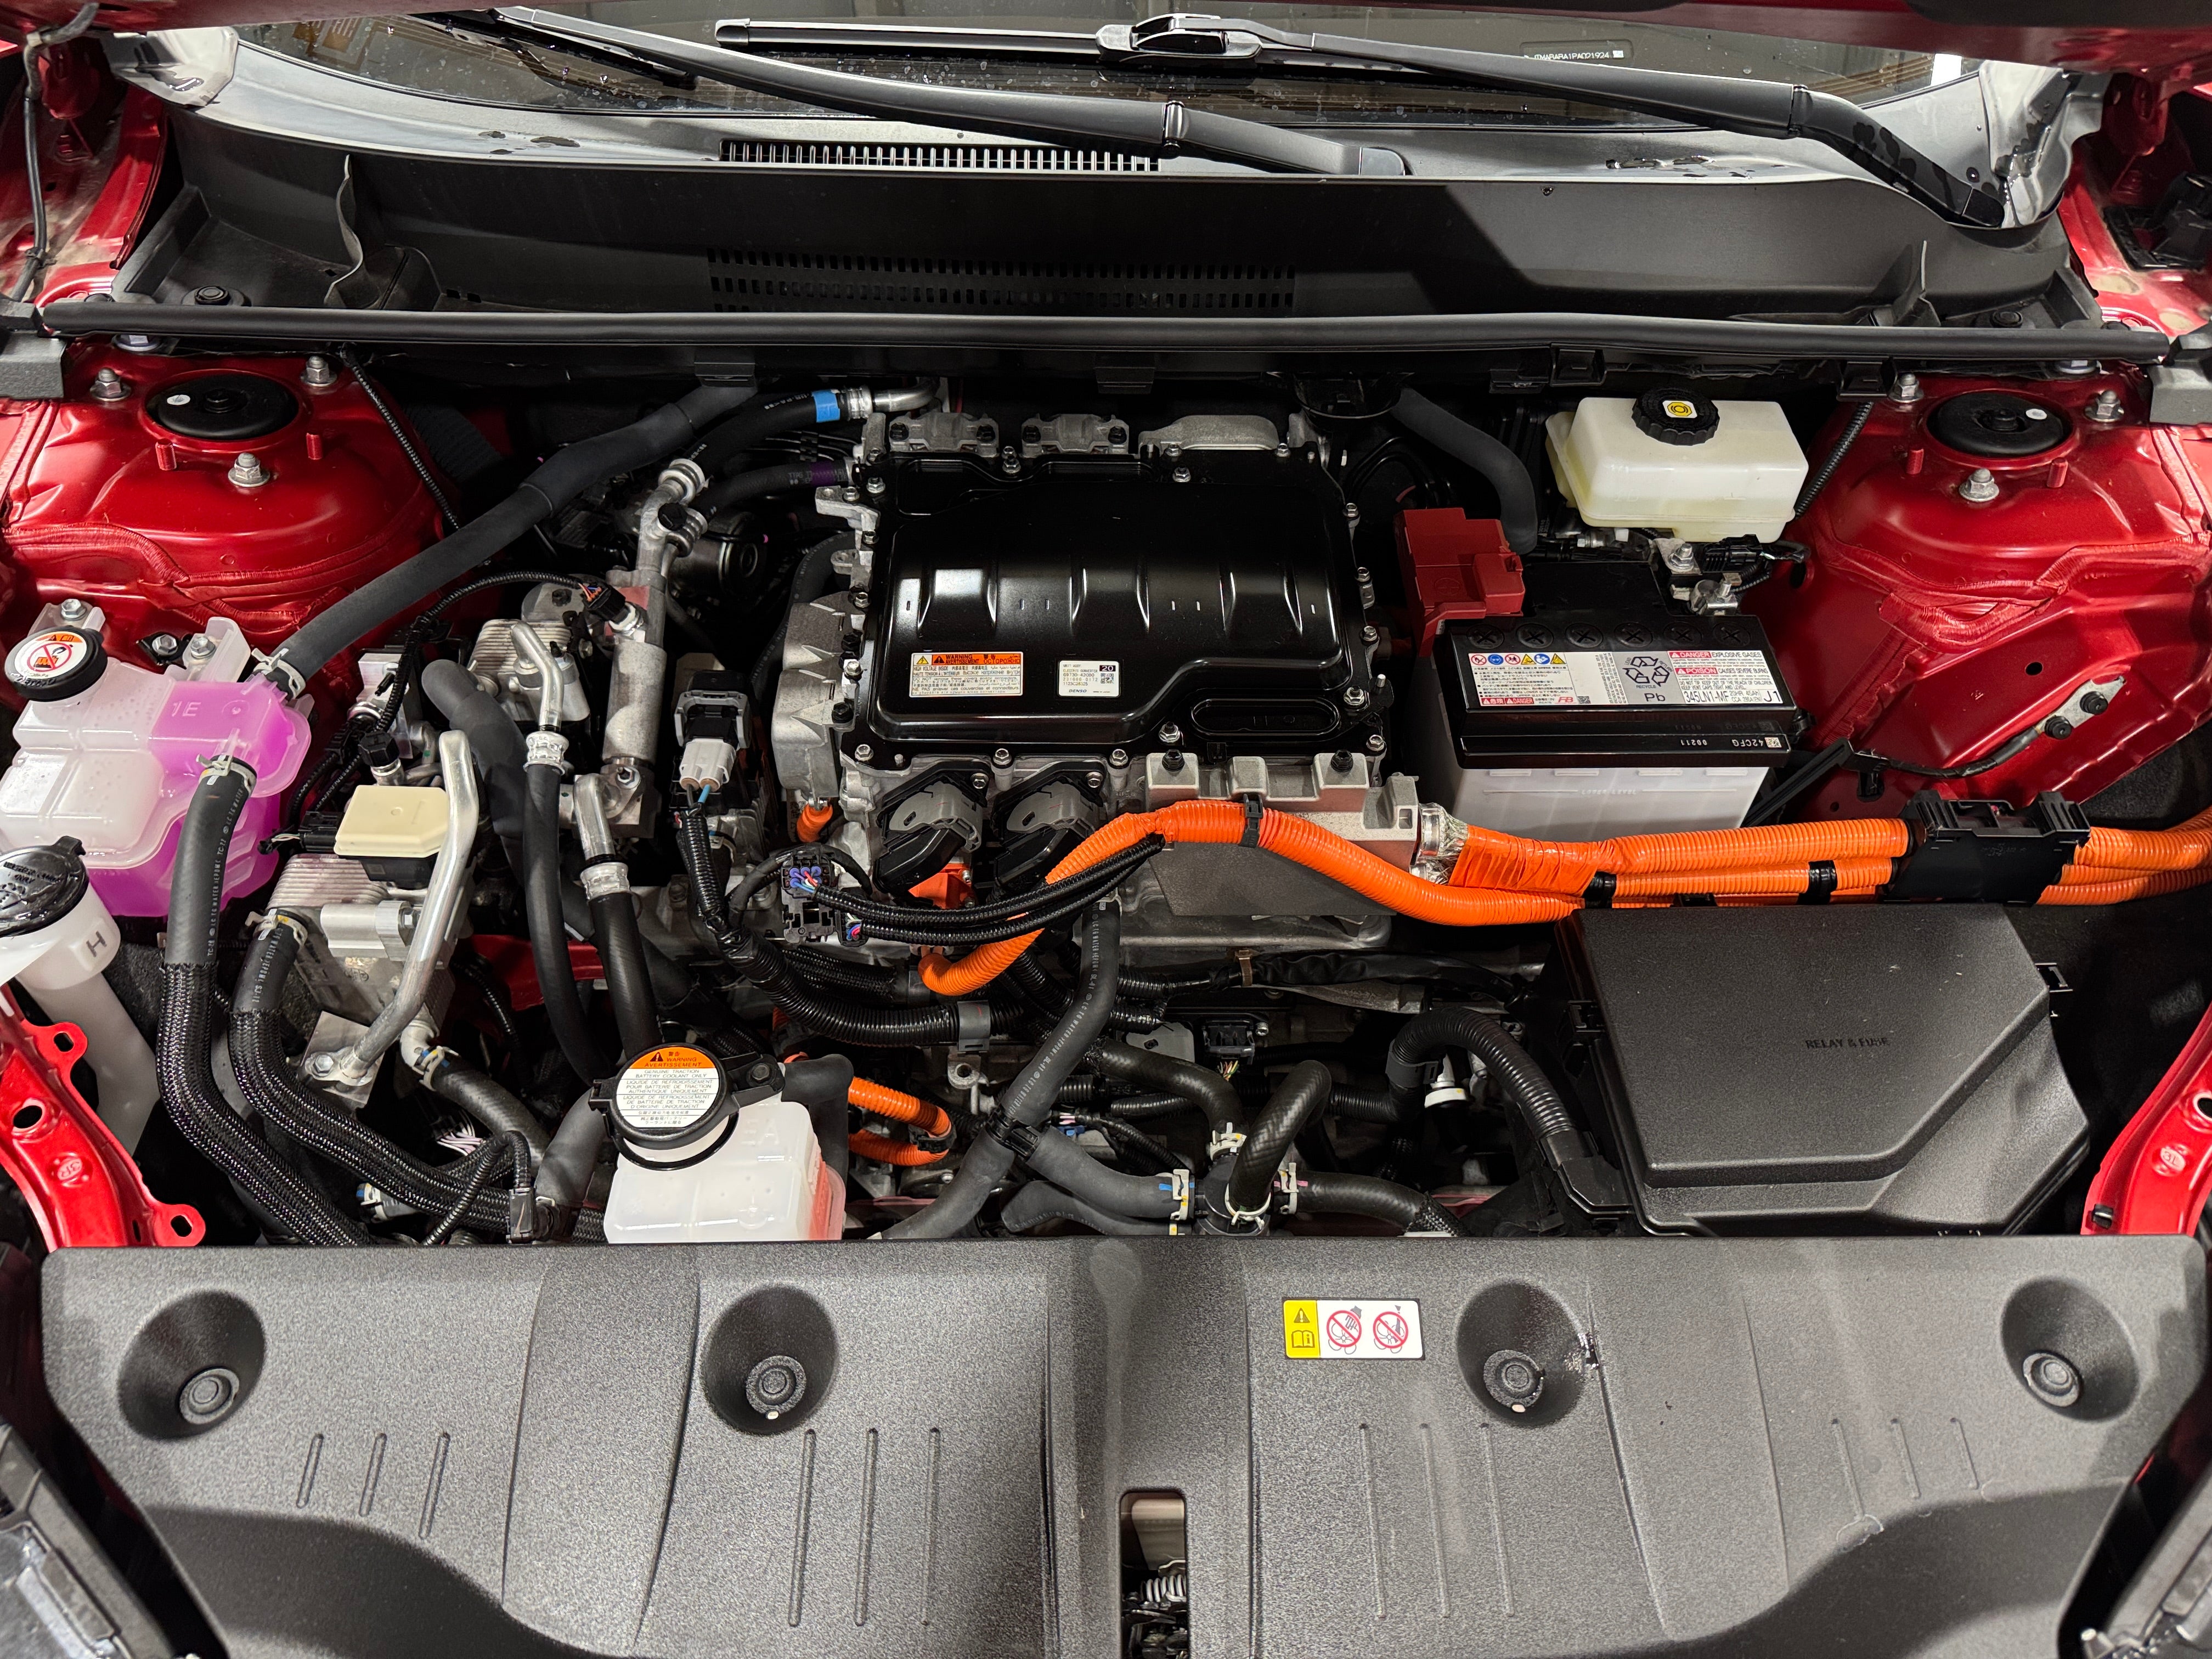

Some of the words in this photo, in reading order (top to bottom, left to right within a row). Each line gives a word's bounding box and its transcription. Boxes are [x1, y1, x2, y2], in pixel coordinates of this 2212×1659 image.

[1644, 693, 1666, 702] Pb
[1684, 691, 1729, 702] 345LN1-MF
[86, 930, 107, 957] H
[1063, 1019, 1080, 1038] WATER
[1805, 1039, 1843, 1049] RELAY
[1848, 1039, 1857, 1047] &
[1858, 1037, 1889, 1047] FUSE
